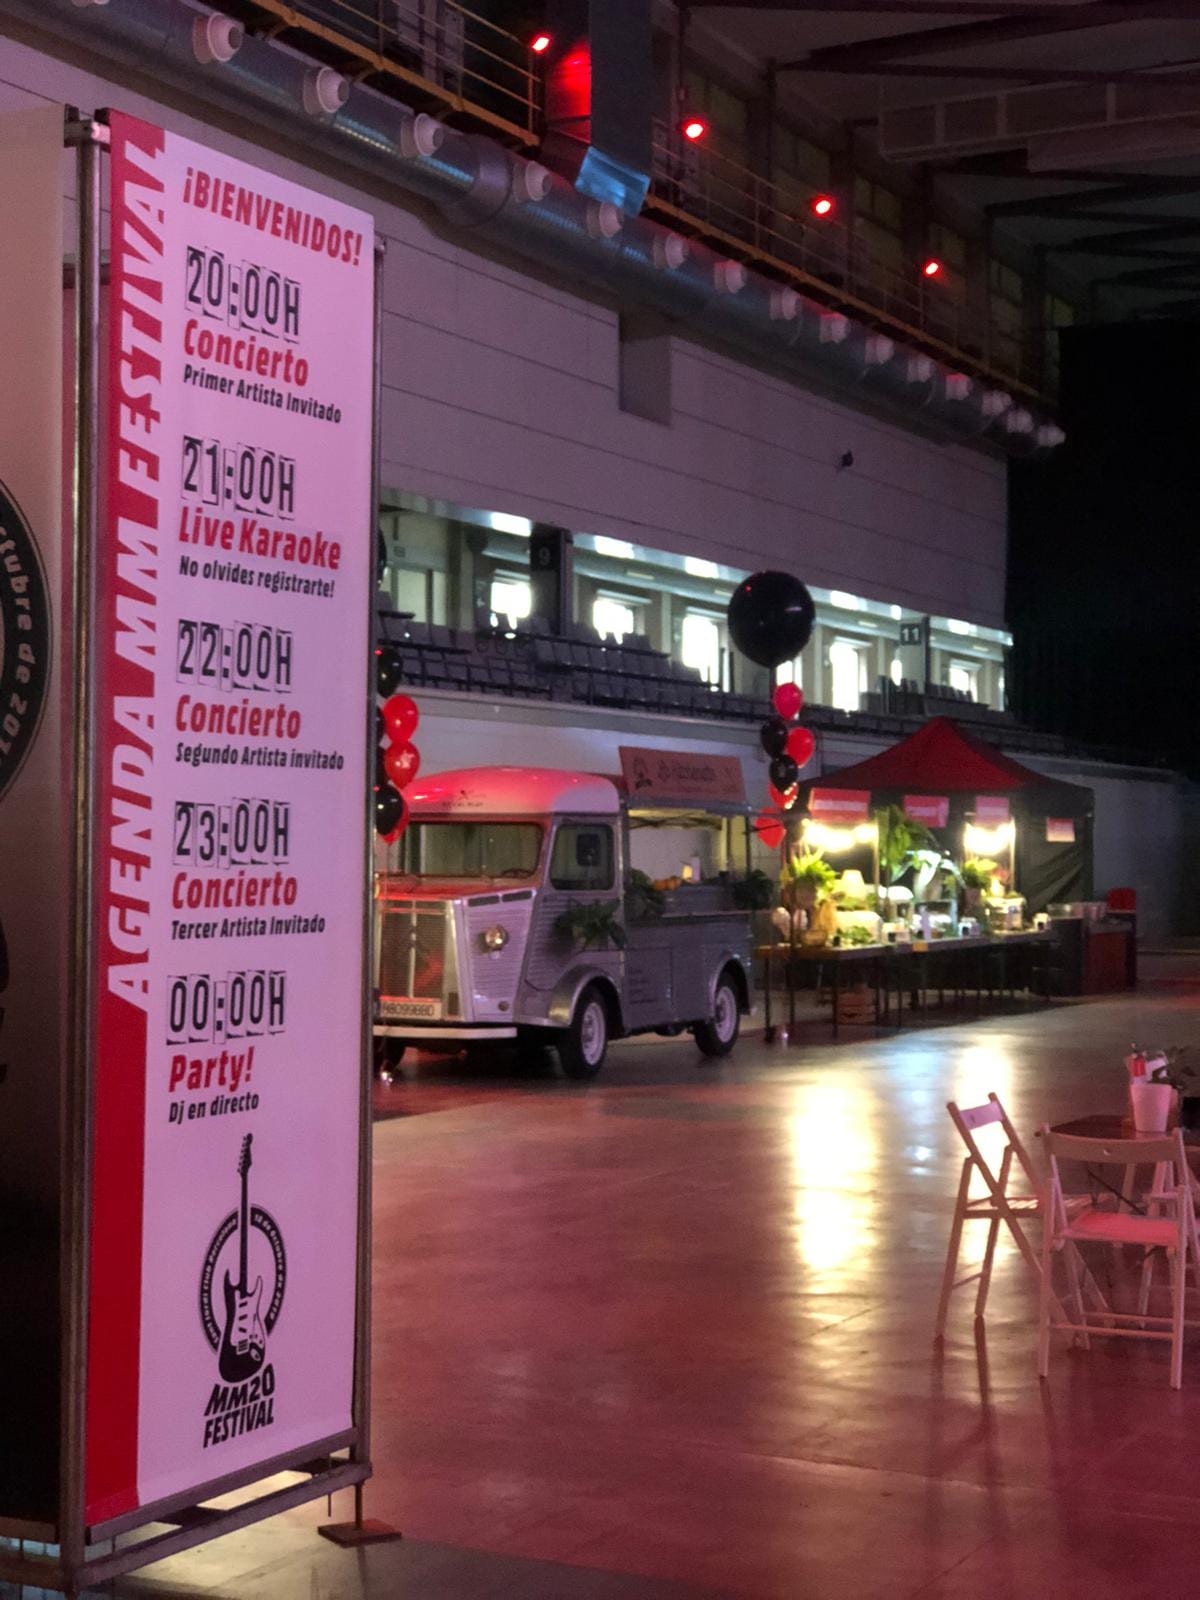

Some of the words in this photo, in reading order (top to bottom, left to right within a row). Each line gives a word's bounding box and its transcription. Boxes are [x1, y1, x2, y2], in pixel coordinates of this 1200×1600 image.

[183, 167, 362, 266] ¡BIENVENIDOS!
[119, 140, 165, 501] FESTIVAL
[185, 246, 301, 338] 20:00H
[184, 319, 308, 387] Concierto
[184, 364, 234, 394] Primer
[236, 380, 284, 408] Artista
[286, 393, 341, 423] Invitado
[182, 435, 296, 515] 21:00H
[179, 506, 234, 549] Live
[238, 519, 341, 571] Karaoke
[114, 517, 159, 672] MM
[179, 556, 198, 577] No
[203, 558, 254, 586] olvides
[257, 572, 335, 598] registrarte!
[16, 642, 36, 684] de
[177, 619, 293, 687] 22:00H
[902, 627, 920, 642] 11
[0, 693, 28, 764] 201
[176, 695, 301, 739] Concierto
[176, 742, 238, 767] Segundo
[241, 747, 287, 767] Artista
[290, 749, 344, 770] invitado
[107, 696, 154, 1013] AGENDA
[174, 799, 290, 862] 23:00H
[172, 871, 297, 909] Concierto
[172, 920, 218, 940] Tercer
[220, 918, 266, 937] Artista
[270, 914, 325, 935] Invitado
[168, 970, 287, 1035] 00:00H
[169, 1046, 254, 1092] Party!
[169, 1100, 185, 1125] Dj
[188, 1102, 206, 1120] en
[210, 1092, 259, 1117] directo
[204, 1363, 275, 1416] MM20
[203, 1398, 274, 1448] FESTIVAL
